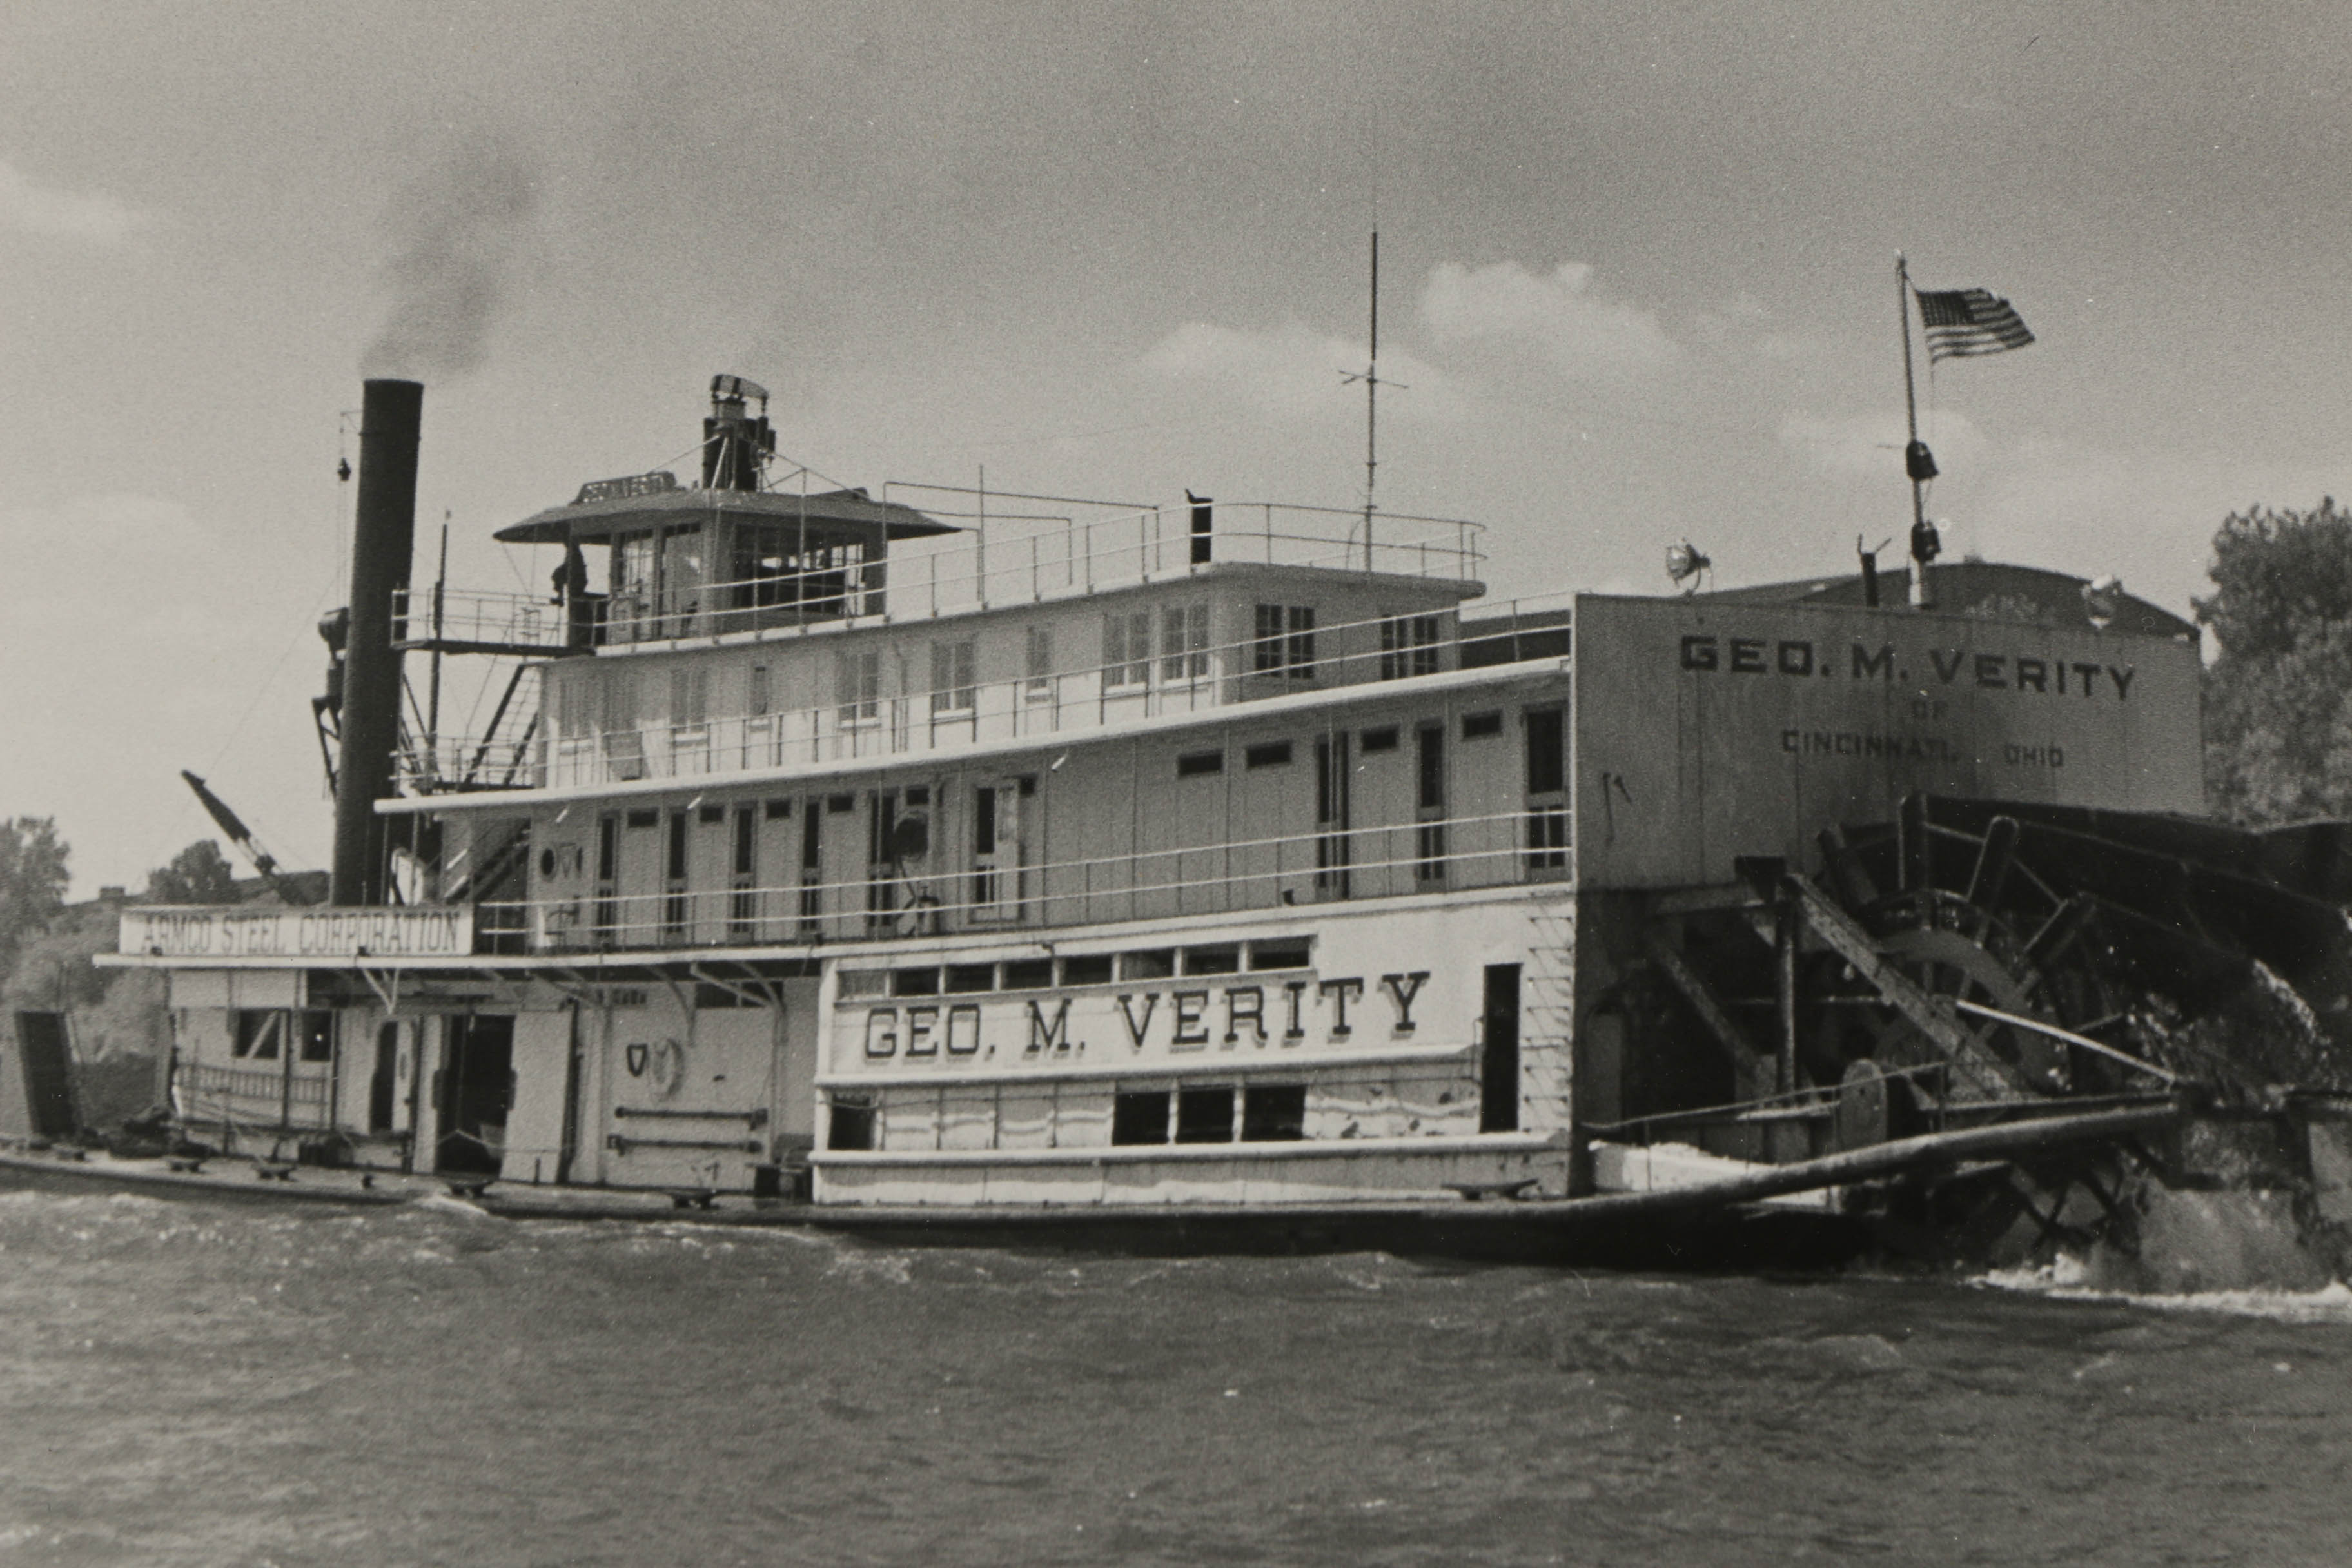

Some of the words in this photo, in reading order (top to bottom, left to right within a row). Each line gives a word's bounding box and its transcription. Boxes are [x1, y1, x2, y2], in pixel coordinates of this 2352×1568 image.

[1680, 635, 1830, 677] GEO.
[1851, 643, 1908, 680] M.
[1930, 649, 2134, 701] VERITY
[2004, 743, 2064, 768] OHIO
[222, 914, 285, 952] STEEL
[299, 910, 460, 952] CORPORATION
[865, 1003, 995, 1059] GEO.
[1026, 999, 1086, 1054] M.
[1117, 972, 1430, 1049] VERITY
